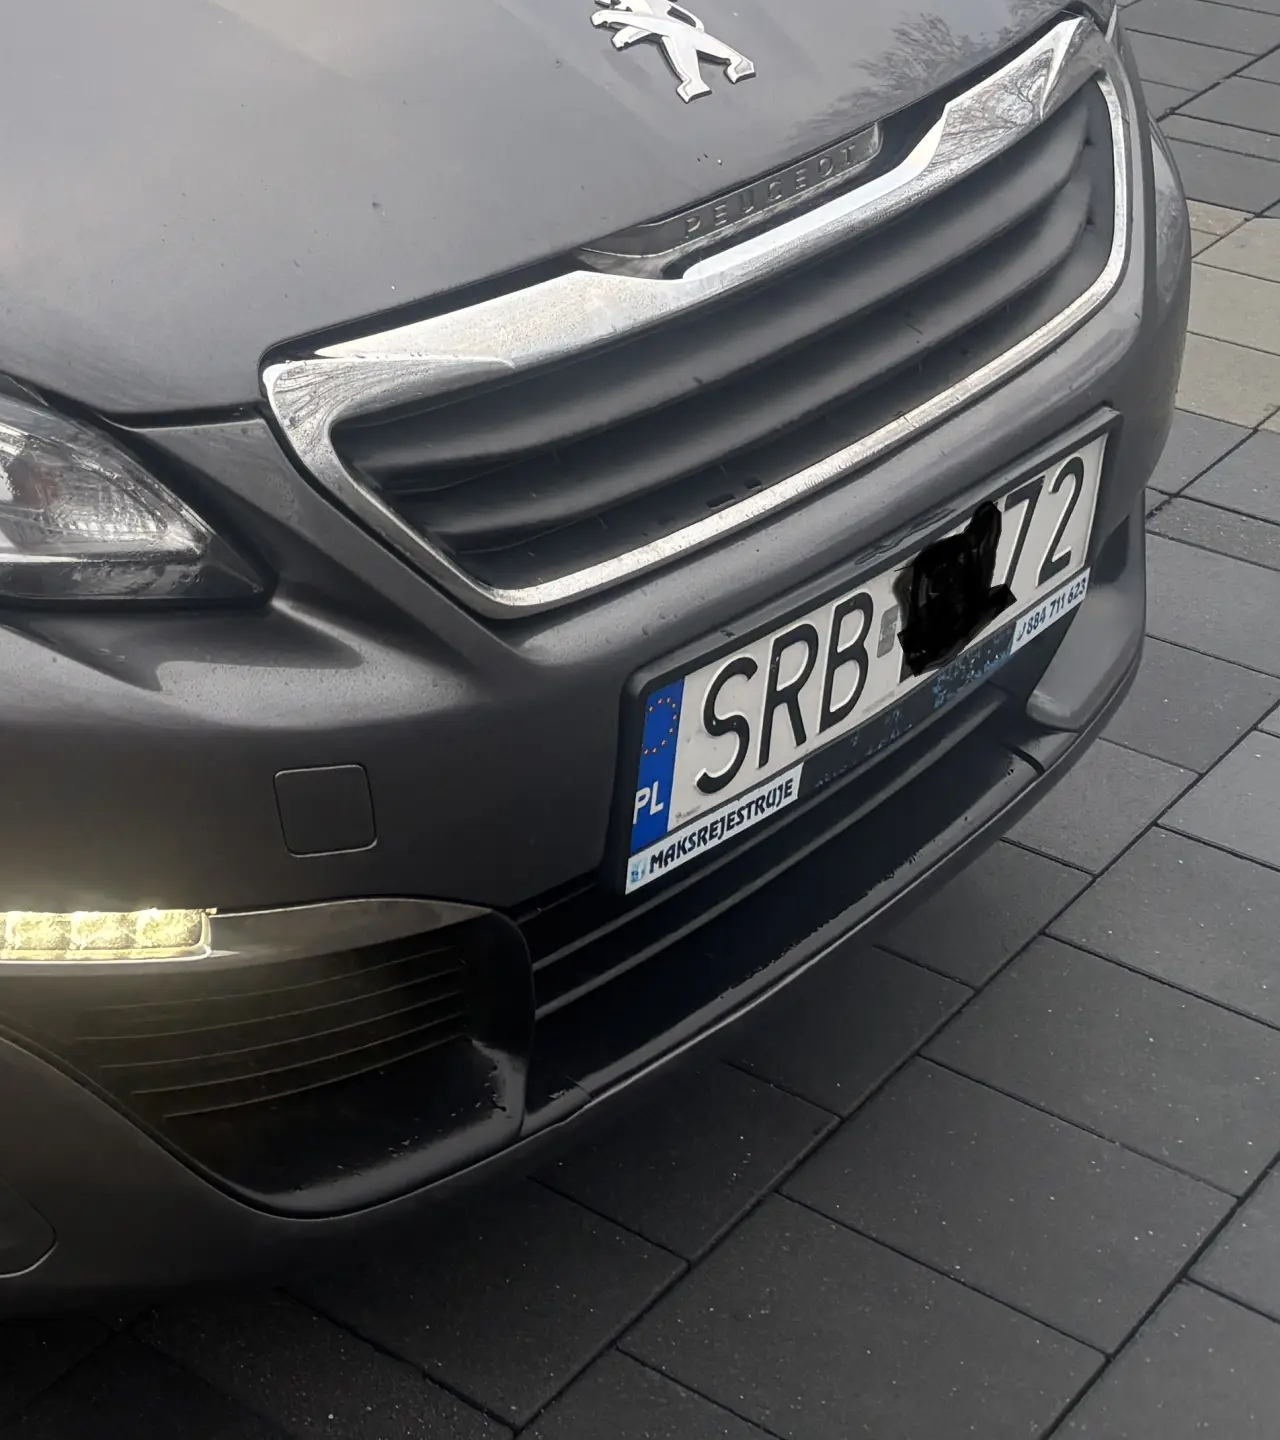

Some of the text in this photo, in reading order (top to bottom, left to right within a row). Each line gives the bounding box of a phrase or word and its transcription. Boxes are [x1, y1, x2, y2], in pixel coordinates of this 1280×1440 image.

[683, 144, 857, 239] PEUGEOT
[1049, 592, 1066, 622] 711
[1067, 576, 1087, 605] 623
[694, 591, 874, 795] SRB
[632, 780, 665, 826] PL
[648, 777, 794, 875] MAKSREJESTRUJE
